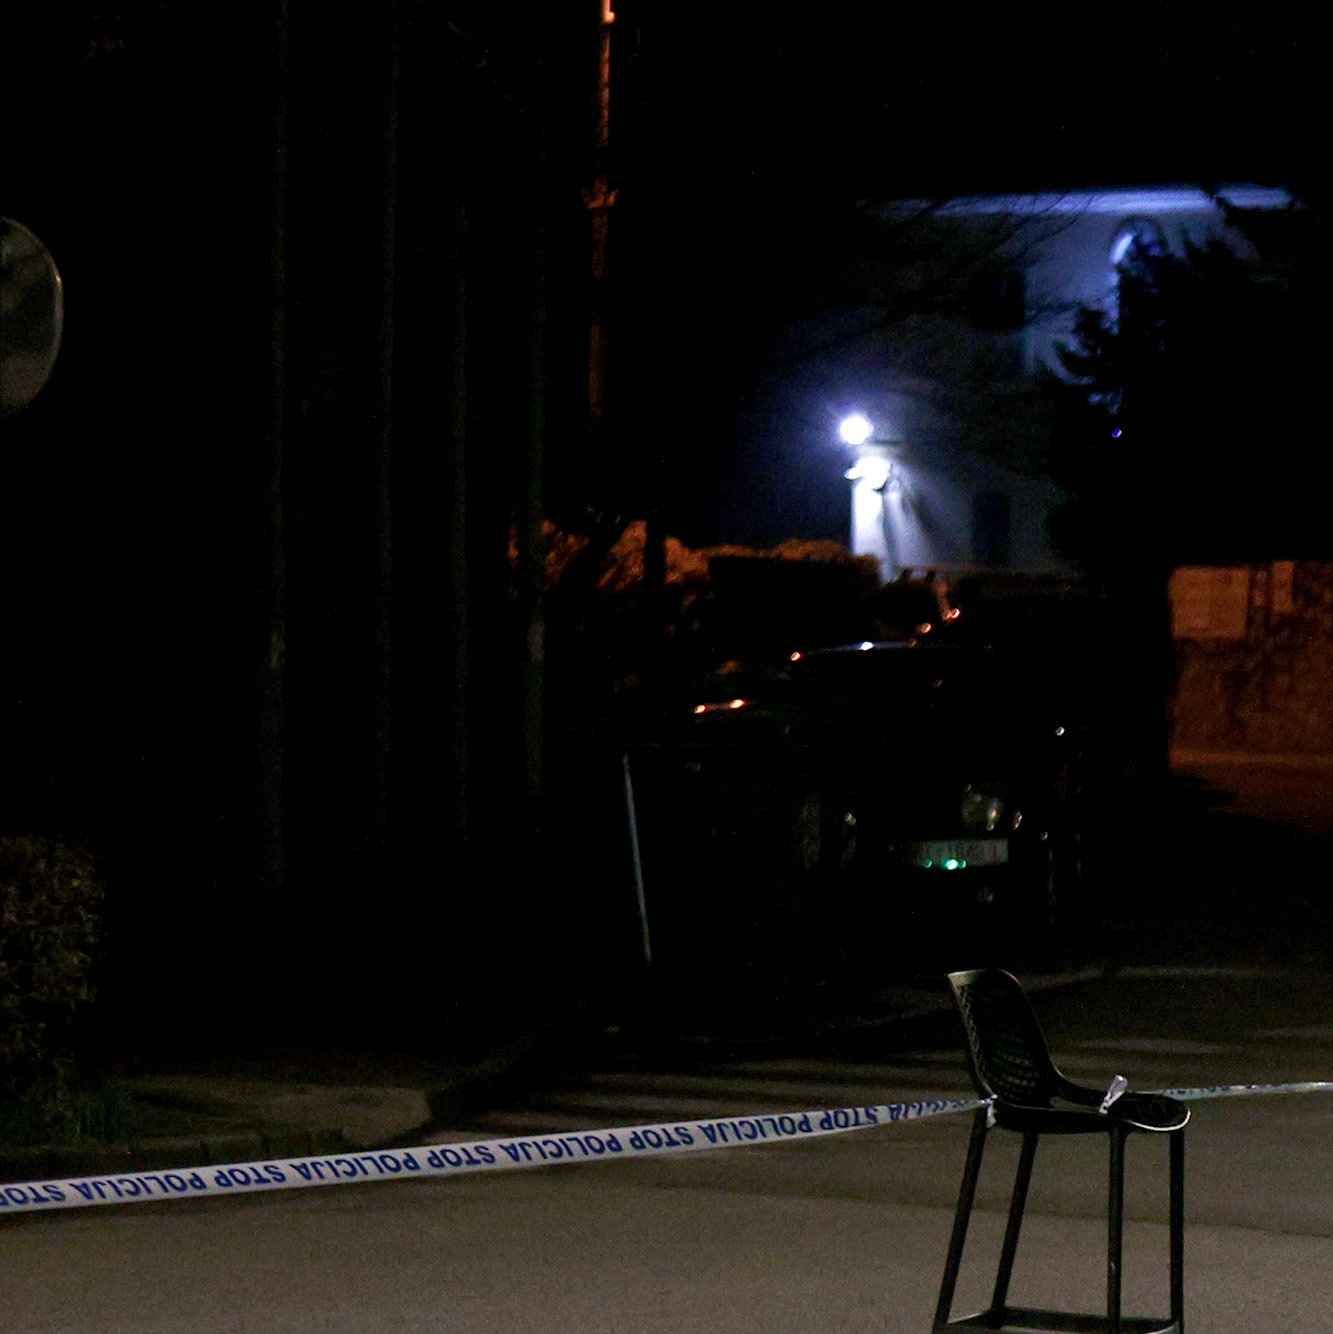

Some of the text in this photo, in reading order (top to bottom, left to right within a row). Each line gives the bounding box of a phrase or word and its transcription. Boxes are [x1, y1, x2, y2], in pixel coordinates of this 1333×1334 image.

[701, 1116, 813, 1145] POLICIJA
[821, 1107, 878, 1130] STOP
[499, 1134, 623, 1163] POLICIJA
[631, 1127, 695, 1151] STOP
[290, 1154, 421, 1182] POLICIJA
[428, 1146, 497, 1170] STOP
[70, 1174, 207, 1202] POLICIJA
[214, 1164, 287, 1190] STOP
